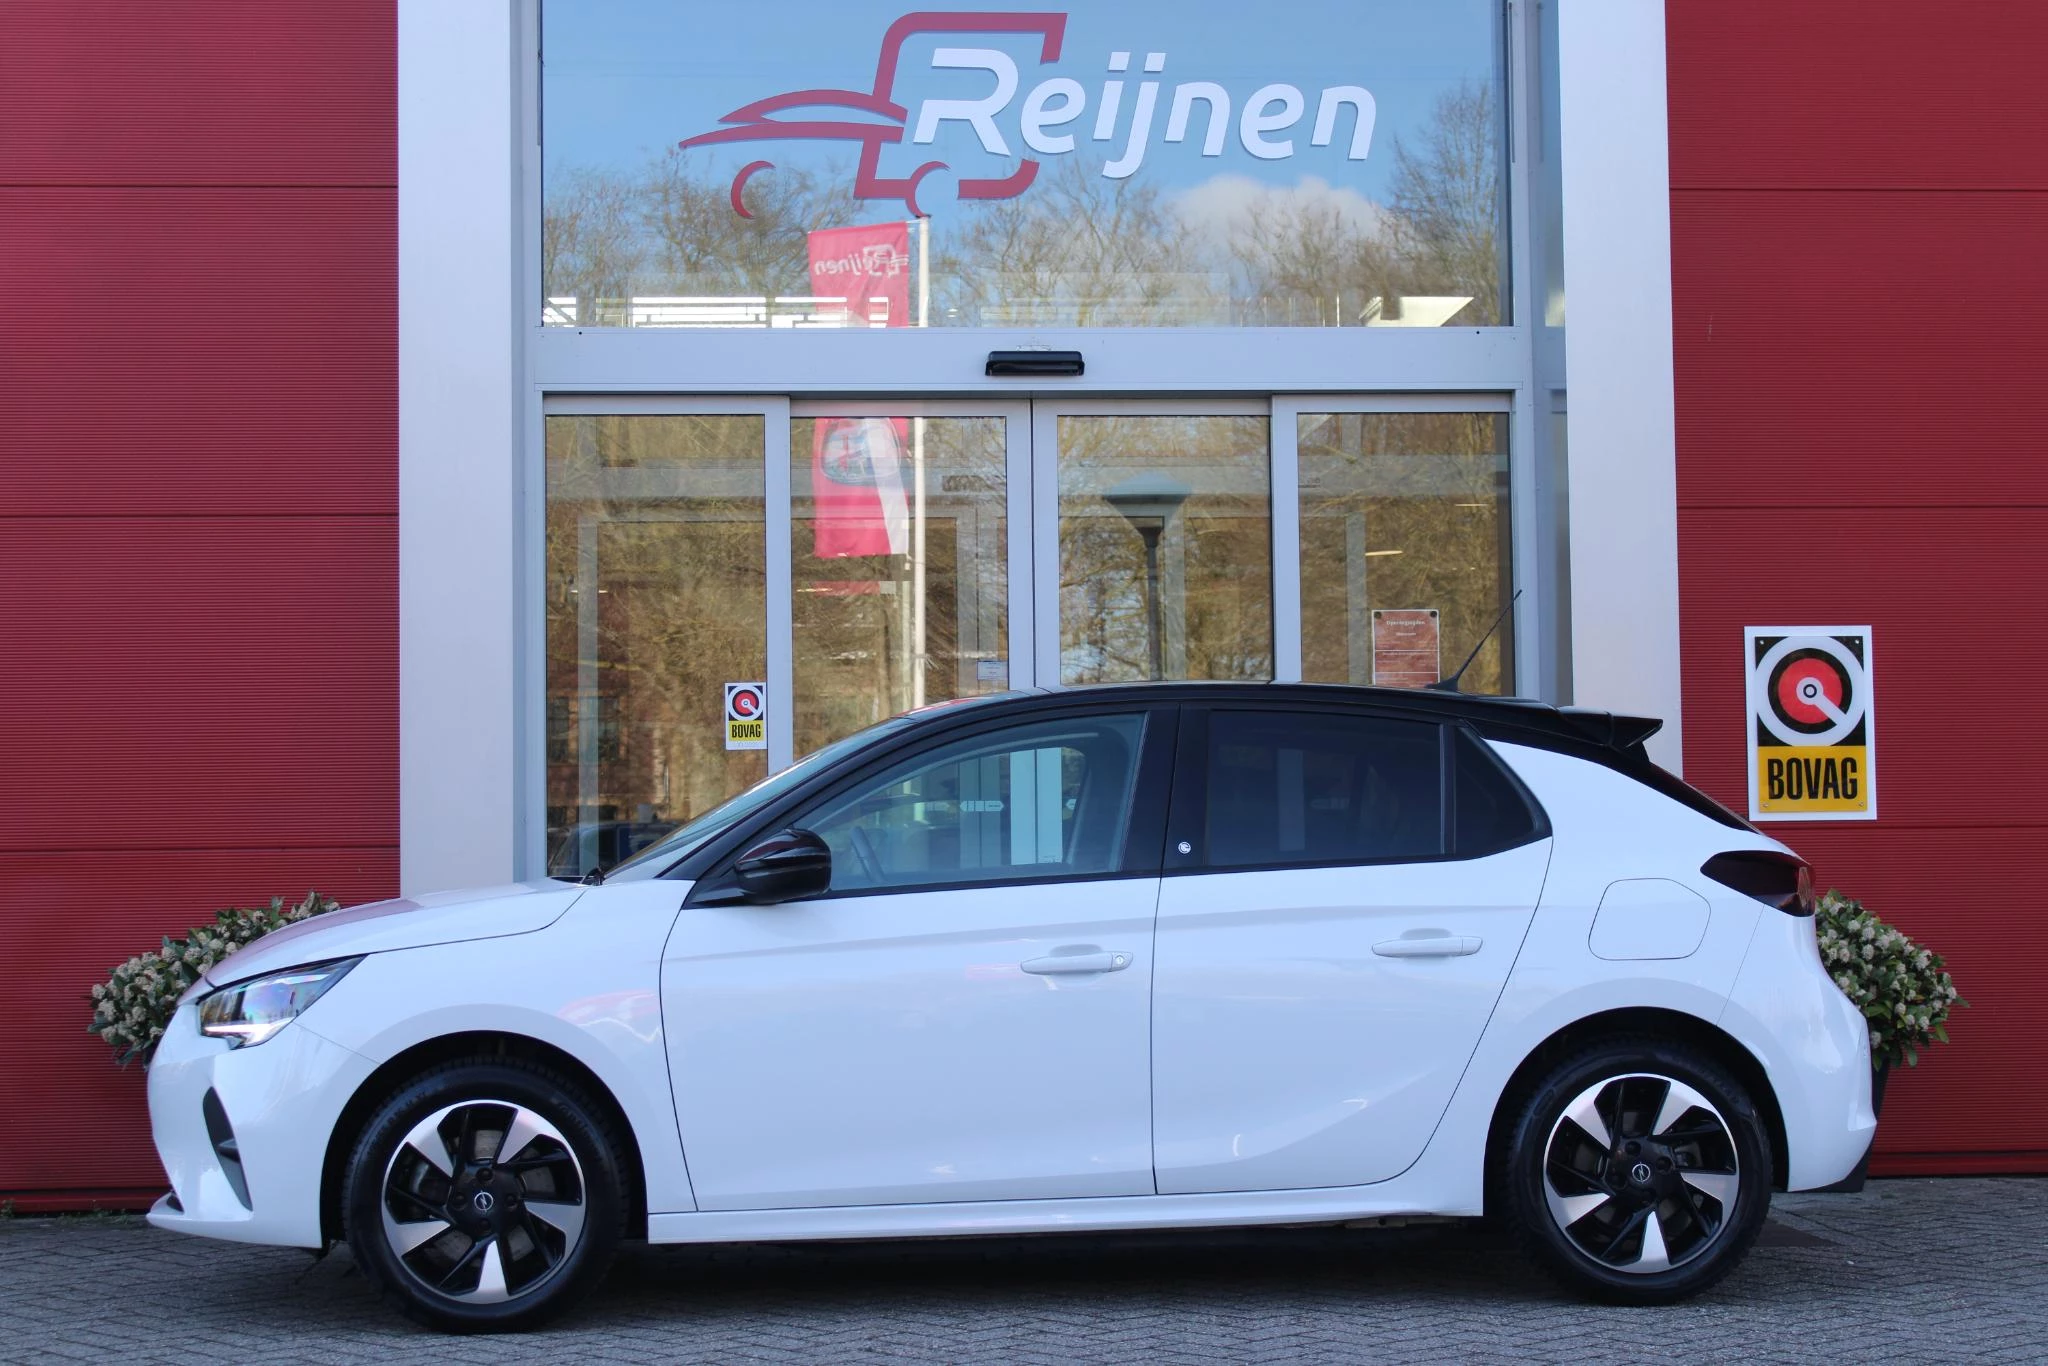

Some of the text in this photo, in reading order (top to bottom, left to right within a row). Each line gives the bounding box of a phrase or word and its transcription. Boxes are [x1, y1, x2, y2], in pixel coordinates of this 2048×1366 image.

[912, 48, 1377, 179] Reijnen
[731, 724, 761, 738] BOVAG
[1767, 757, 1858, 800] BOVAG
